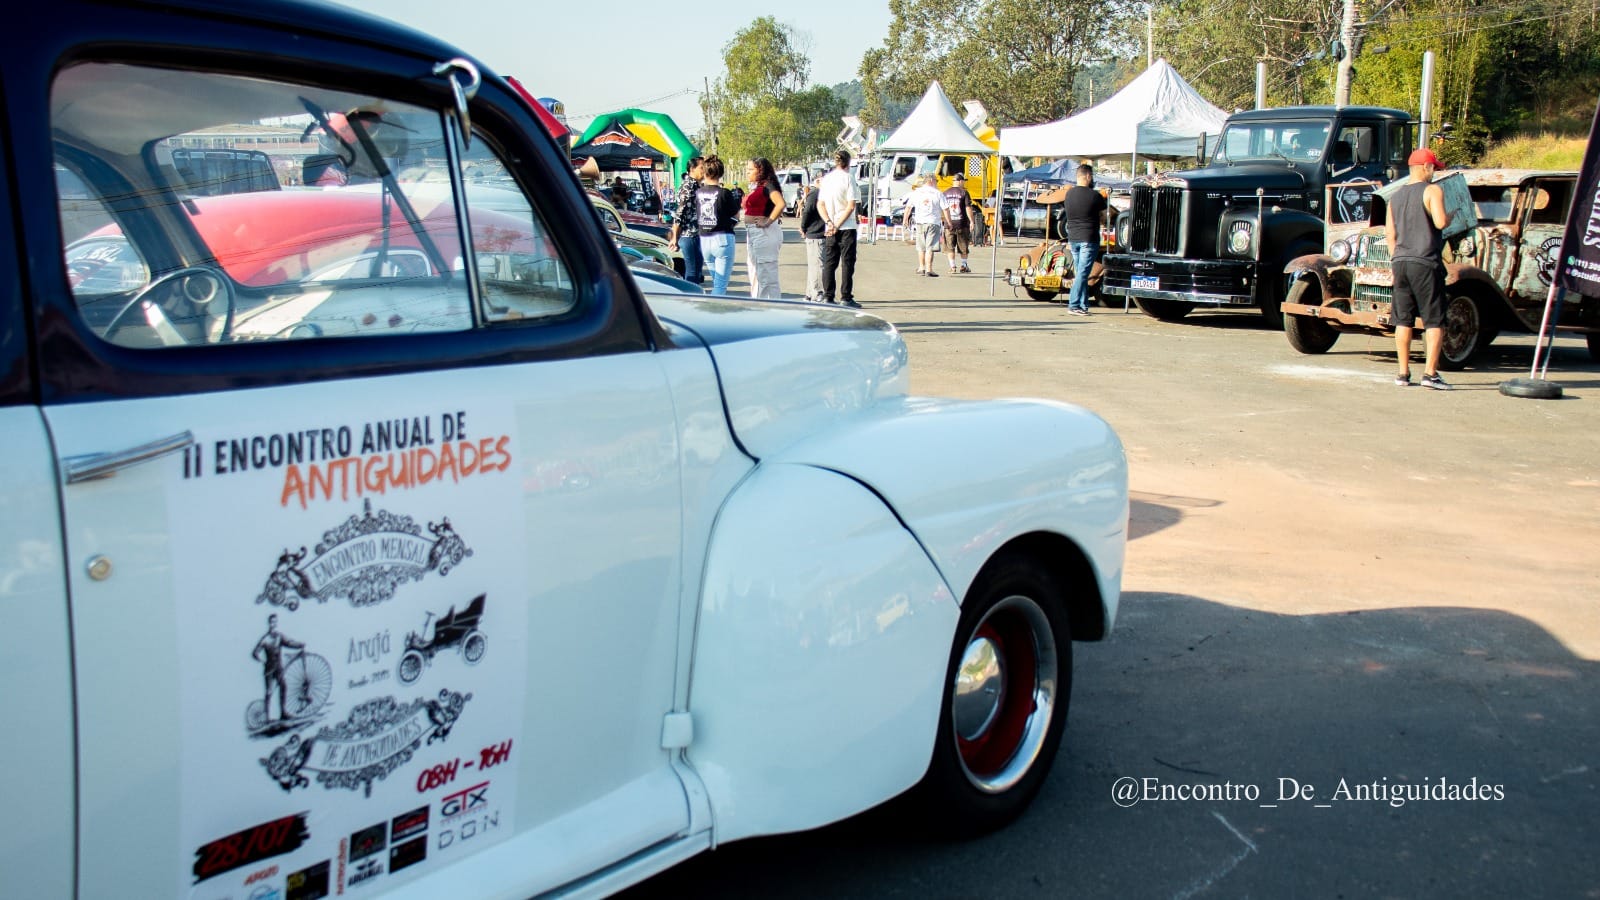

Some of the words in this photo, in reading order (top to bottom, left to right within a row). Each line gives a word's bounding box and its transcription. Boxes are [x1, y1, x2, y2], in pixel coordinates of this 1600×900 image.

[215, 425, 351, 475] ENCONTRO
[361, 415, 434, 454] ANUAL
[442, 411, 466, 441] DE
[280, 435, 512, 510] ANTIGUIDADES
[313, 539, 376, 585] ENCONTRO
[380, 538, 425, 565] MENSAL
[322, 743, 338, 767] DE
[340, 716, 421, 767] ANTIGUIDADES
[416, 757, 460, 792] 08H
[479, 738, 512, 771] 16H
[441, 780, 490, 816] GTX
[201, 815, 296, 873] 28/07
